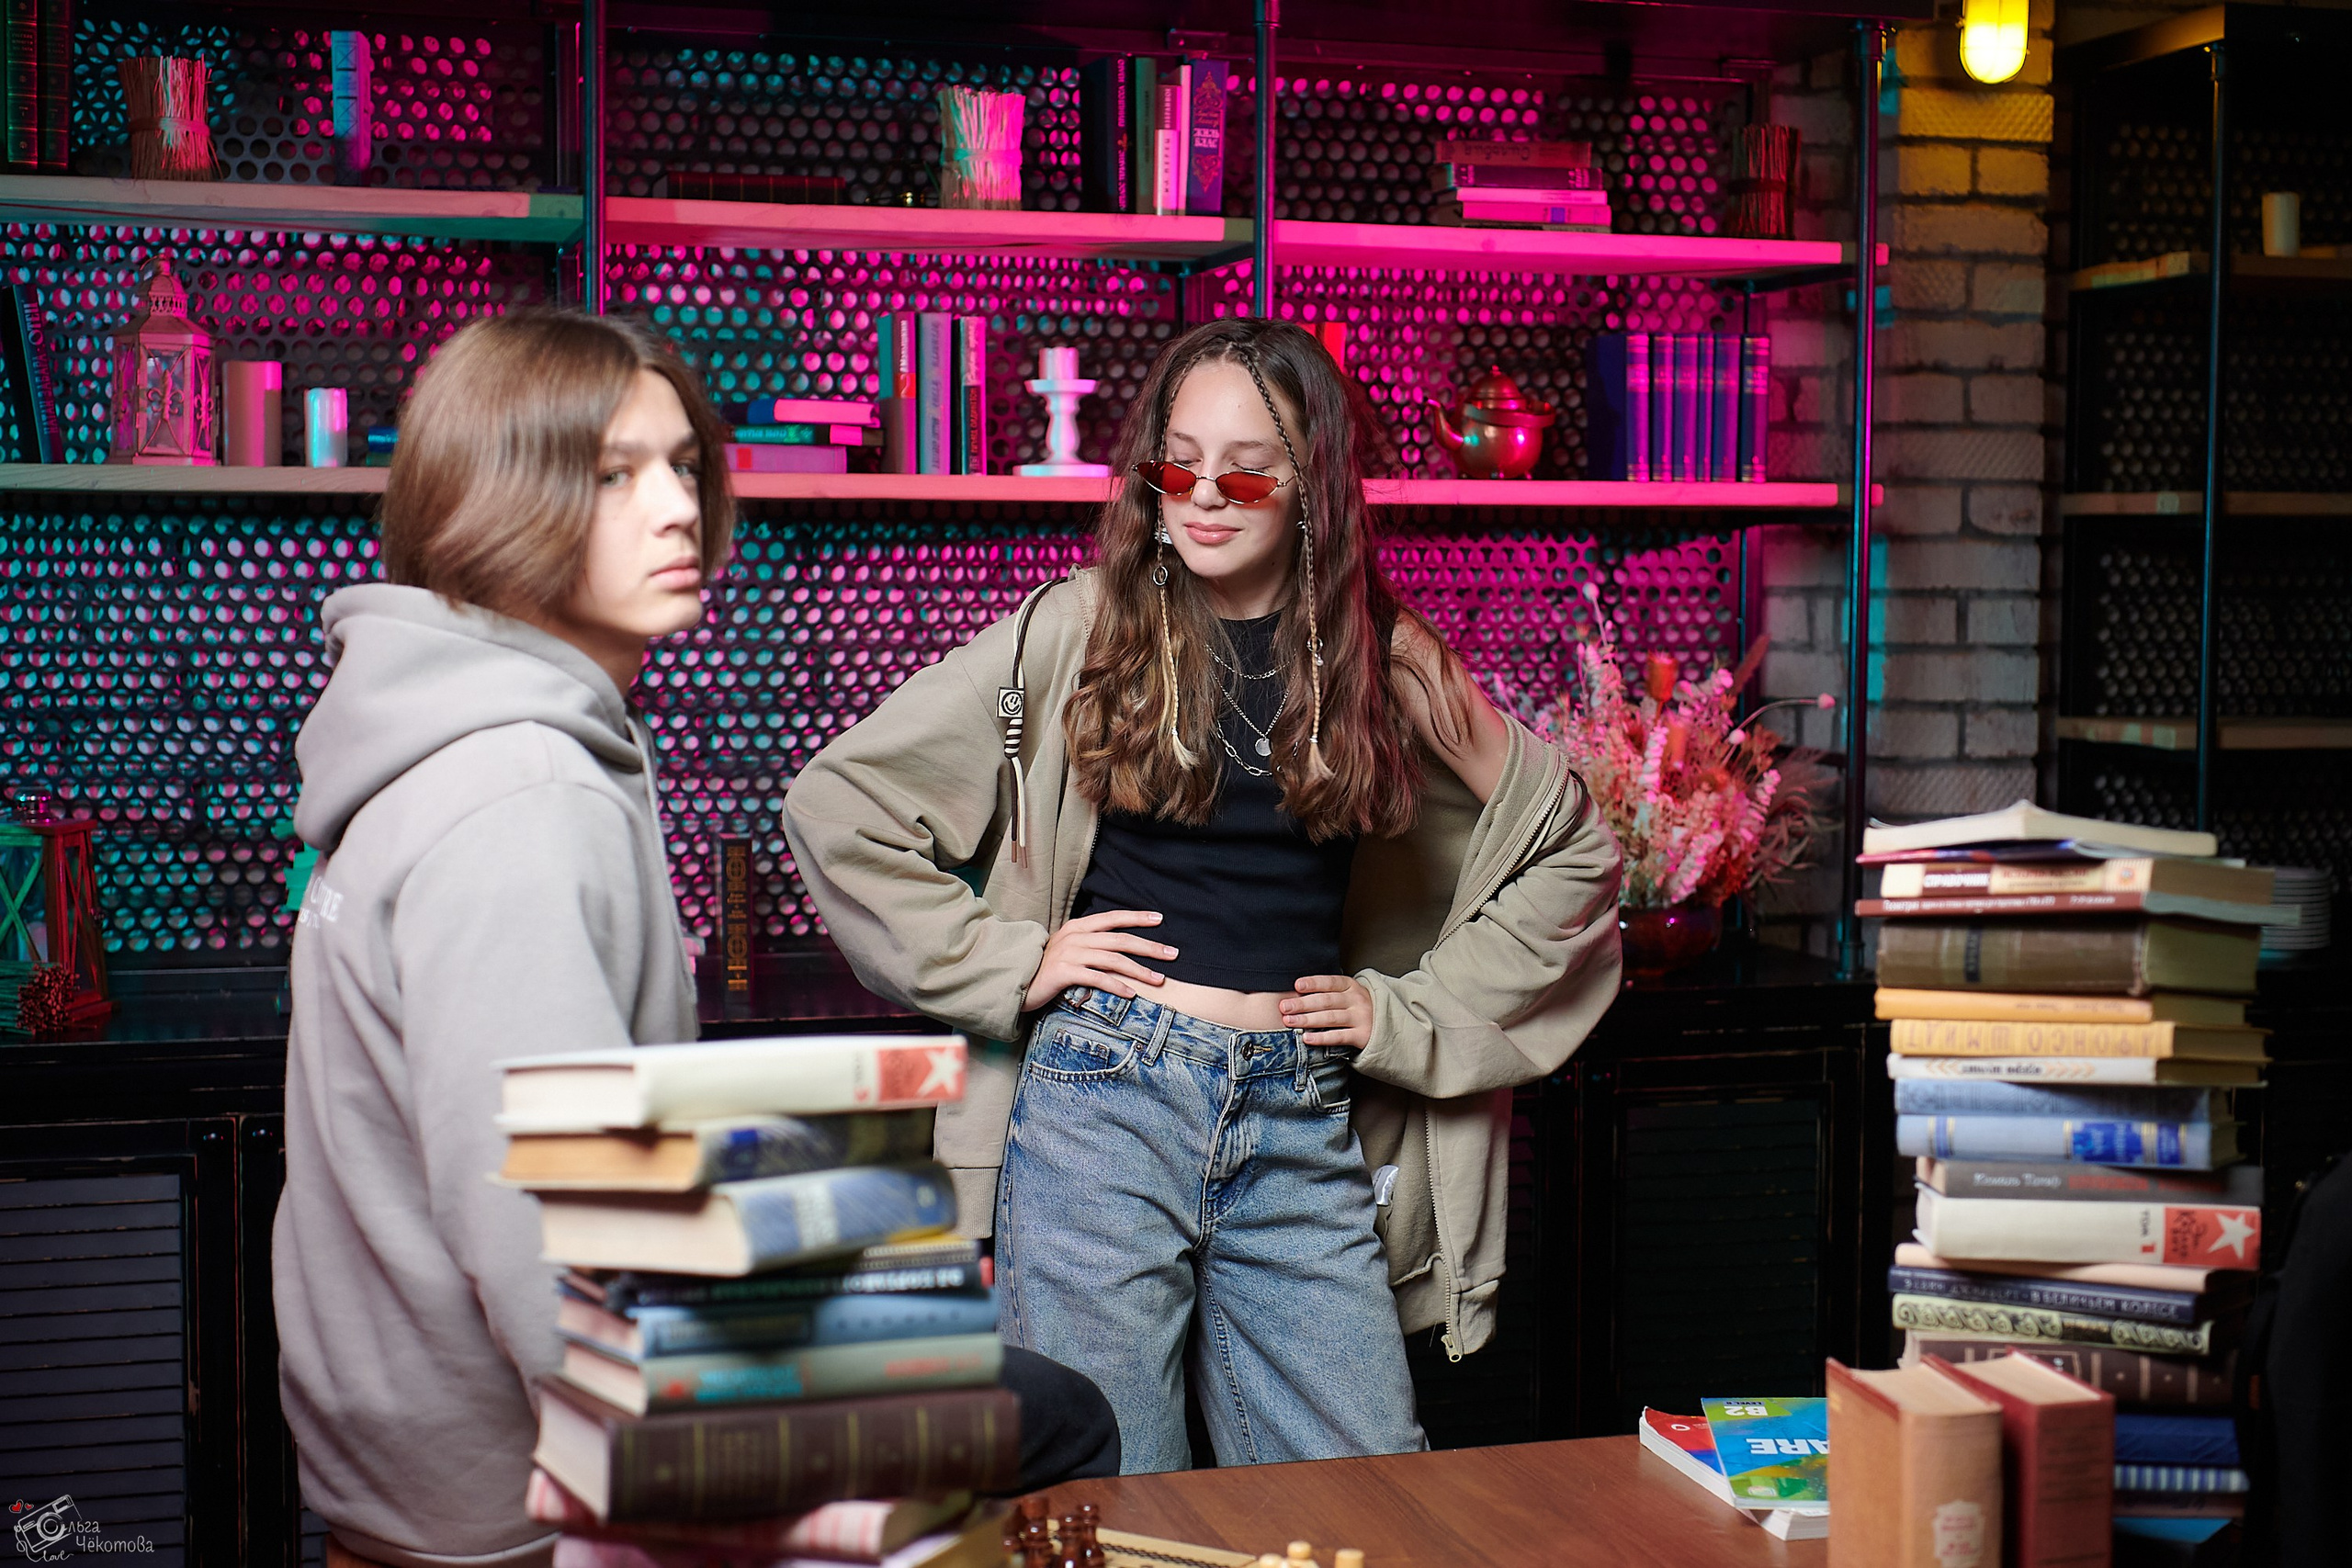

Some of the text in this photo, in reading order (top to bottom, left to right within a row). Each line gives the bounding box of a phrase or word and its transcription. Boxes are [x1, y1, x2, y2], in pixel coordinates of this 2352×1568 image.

[22, 301, 59, 434] НАТАН ЗАБАРА ОТЕЦ
[2030, 1290, 2041, 1303] В
[2042, 1292, 2116, 1312] БЕЛИЧЬЕМ
[2120, 1299, 2179, 1318] КОЛЕСЕ
[1723, 1405, 1770, 1416] B2
